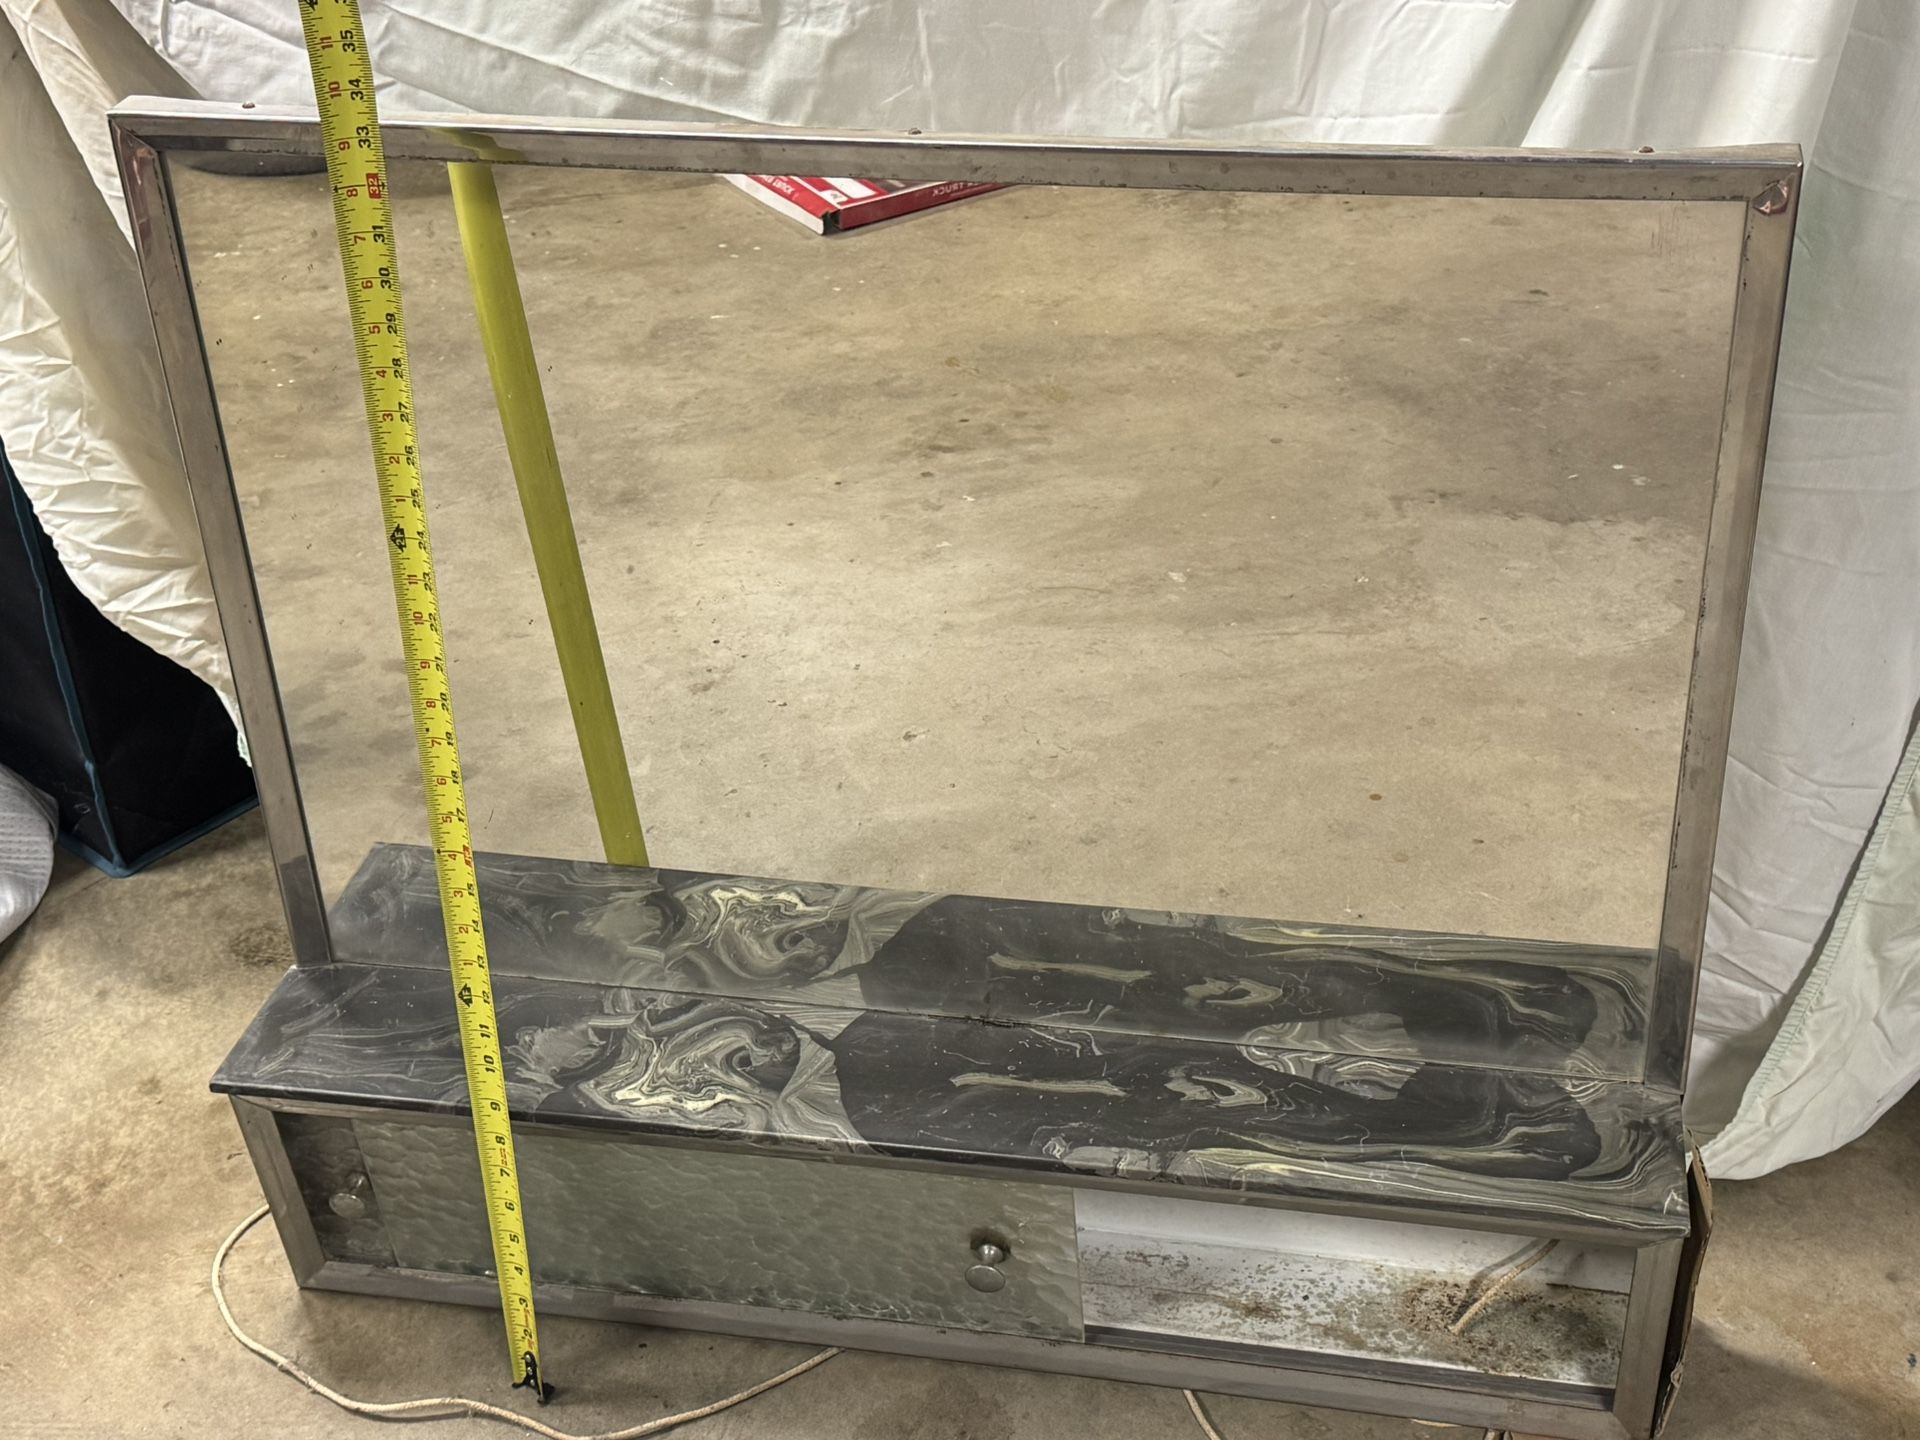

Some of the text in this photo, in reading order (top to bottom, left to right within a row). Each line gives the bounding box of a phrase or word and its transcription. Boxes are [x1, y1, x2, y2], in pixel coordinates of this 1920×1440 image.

[320, 36, 334, 50] 11
[340, 30, 356, 52] 35
[328, 81, 342, 99] 10
[348, 78, 364, 101] 34
[356, 126, 371, 149] 33
[338, 141, 351, 151] 9
[346, 188, 358, 198] 8
[368, 177, 379, 195] 32
[353, 235, 366, 244] 7
[372, 225, 385, 243] 31
[361, 280, 373, 289] 6
[378, 267, 392, 289] 30
[368, 325, 381, 334] 5
[385, 313, 398, 335] 29
[375, 369, 387, 378] 4
[392, 357, 404, 379] 28
[382, 413, 394, 422] 3
[398, 402, 410, 423] 27
[388, 456, 400, 465] 2
[404, 445, 415, 467] 26
[410, 489, 421, 509] 25
[394, 530, 405, 546] 2F
[416, 531, 427, 550] 24
[407, 574, 418, 585] 11
[423, 572, 433, 592] 23
[413, 611, 424, 626] 10
[428, 613, 438, 633] 22
[420, 661, 430, 669] 9
[435, 656, 444, 673] 21
[426, 700, 436, 709] 8
[439, 693, 449, 712] 20
[431, 738, 442, 747] 7
[446, 731, 454, 747] 19
[436, 777, 447, 785] 6
[450, 770, 459, 785] 18
[441, 815, 453, 823] 5
[455, 808, 464, 823] 17
[448, 853, 457, 861] 4
[453, 890, 464, 898] 3
[467, 883, 475, 897] 15
[458, 926, 469, 934] 2
[472, 920, 480, 934] 14
[477, 955, 485, 969] 13
[482, 991, 490, 1005] 12
[479, 1024, 491, 1039] 11
[483, 1055, 496, 1073] 10
[490, 1102, 501, 1112] 9
[495, 1135, 506, 1145] 8
[500, 1168, 511, 1178] 7
[505, 1201, 515, 1211] 6
[509, 1234, 520, 1244] 5
[514, 1266, 524, 1276] 4
[519, 1297, 529, 1308] 3
[523, 1328, 533, 1339] 2
